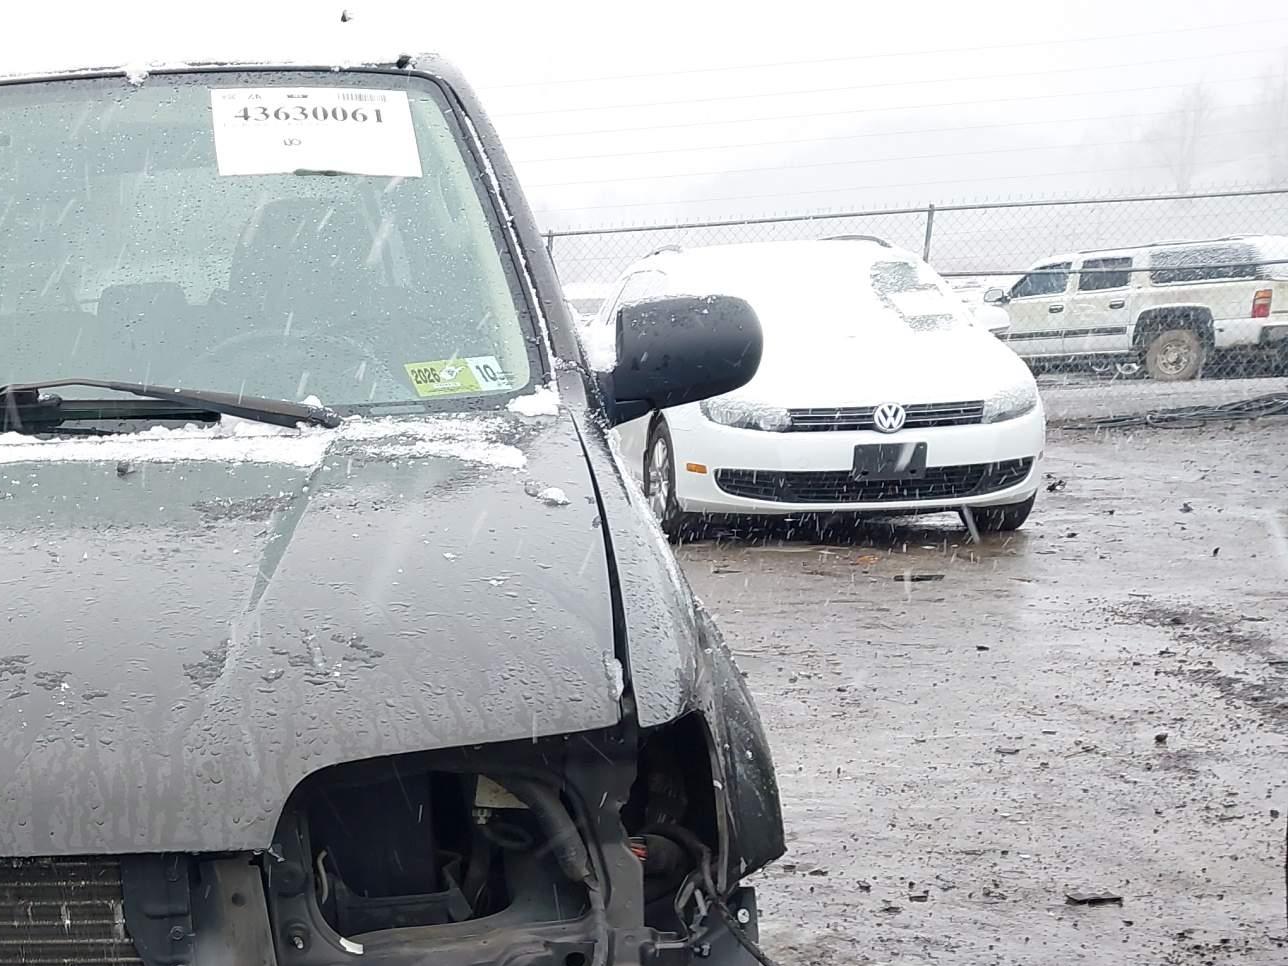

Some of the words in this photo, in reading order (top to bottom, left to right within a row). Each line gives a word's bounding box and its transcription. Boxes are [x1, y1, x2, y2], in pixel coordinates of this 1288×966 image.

[234, 105, 383, 123] 43630061
[410, 367, 441, 385] 2026
[475, 363, 498, 383] 10
[875, 404, 905, 431] VW
